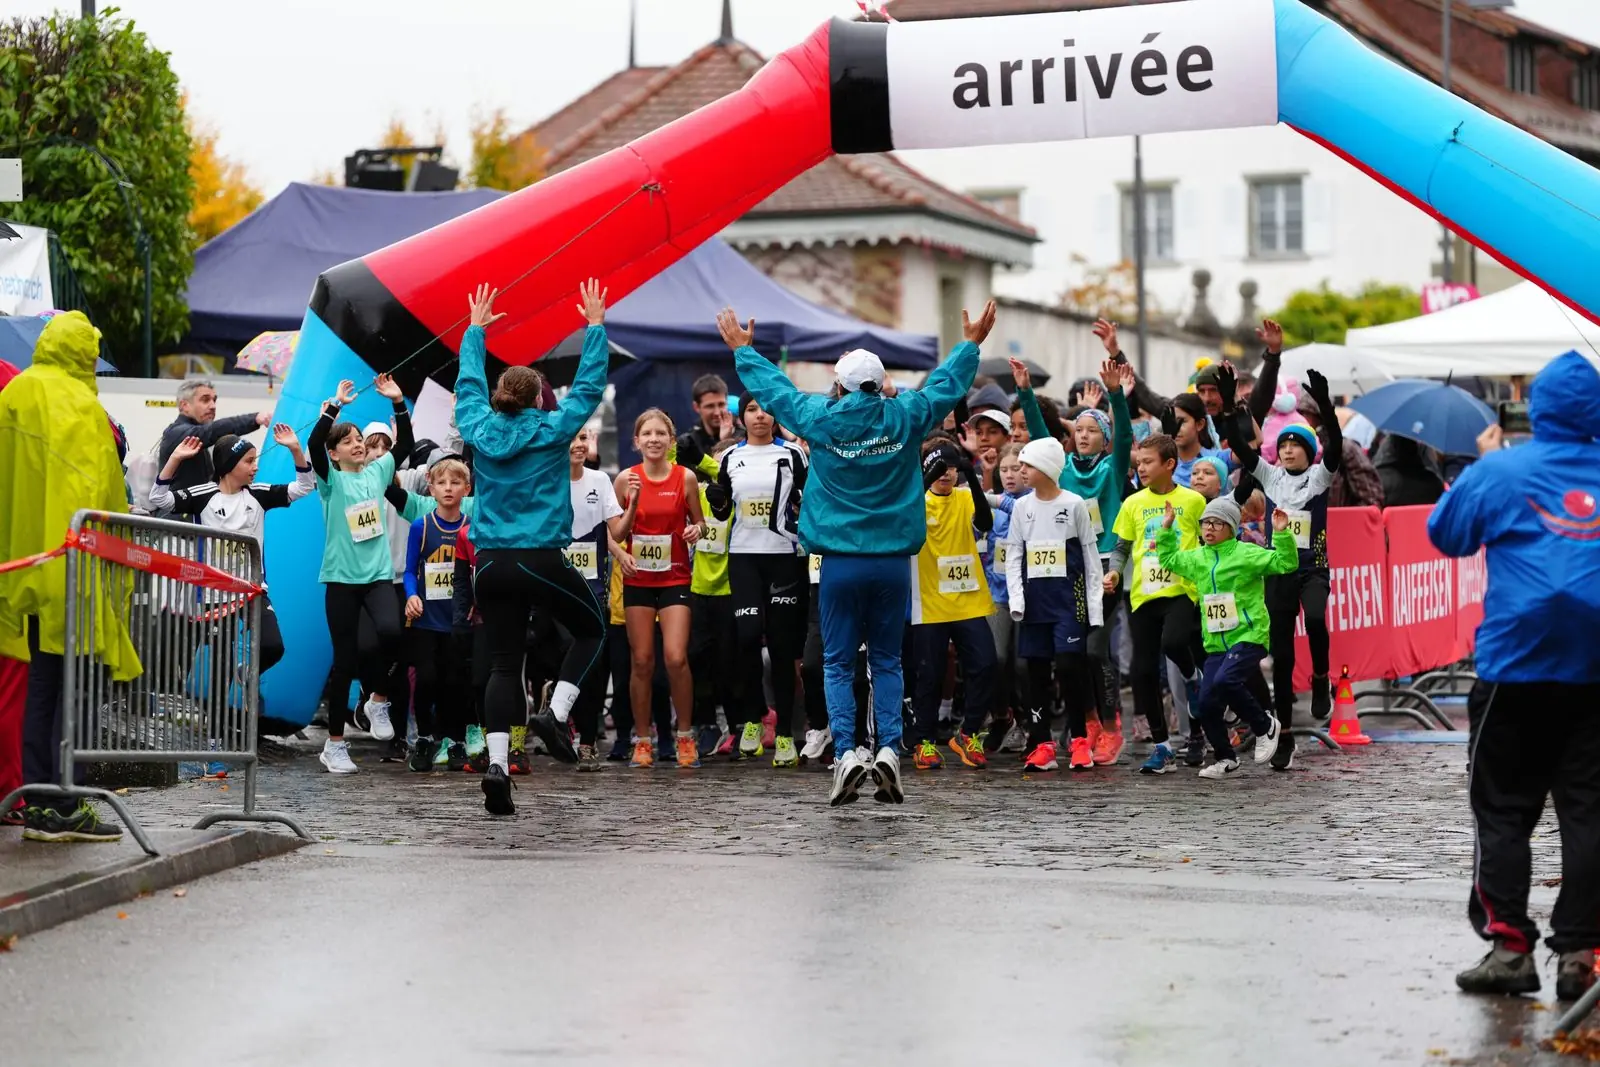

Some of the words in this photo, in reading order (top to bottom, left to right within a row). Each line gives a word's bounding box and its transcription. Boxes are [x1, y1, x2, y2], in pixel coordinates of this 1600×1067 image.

[952, 31, 1214, 110] arrivée
[750, 502, 772, 516] 355
[357, 510, 376, 527] 444
[640, 545, 662, 560] 440
[1034, 550, 1056, 565] 375
[948, 565, 970, 581] 434
[1149, 568, 1171, 583] 342
[770, 596, 798, 605] PRO
[1328, 562, 1384, 632] FEISEN
[1392, 558, 1452, 628] RAIFFEISEN
[1207, 604, 1227, 620] 478
